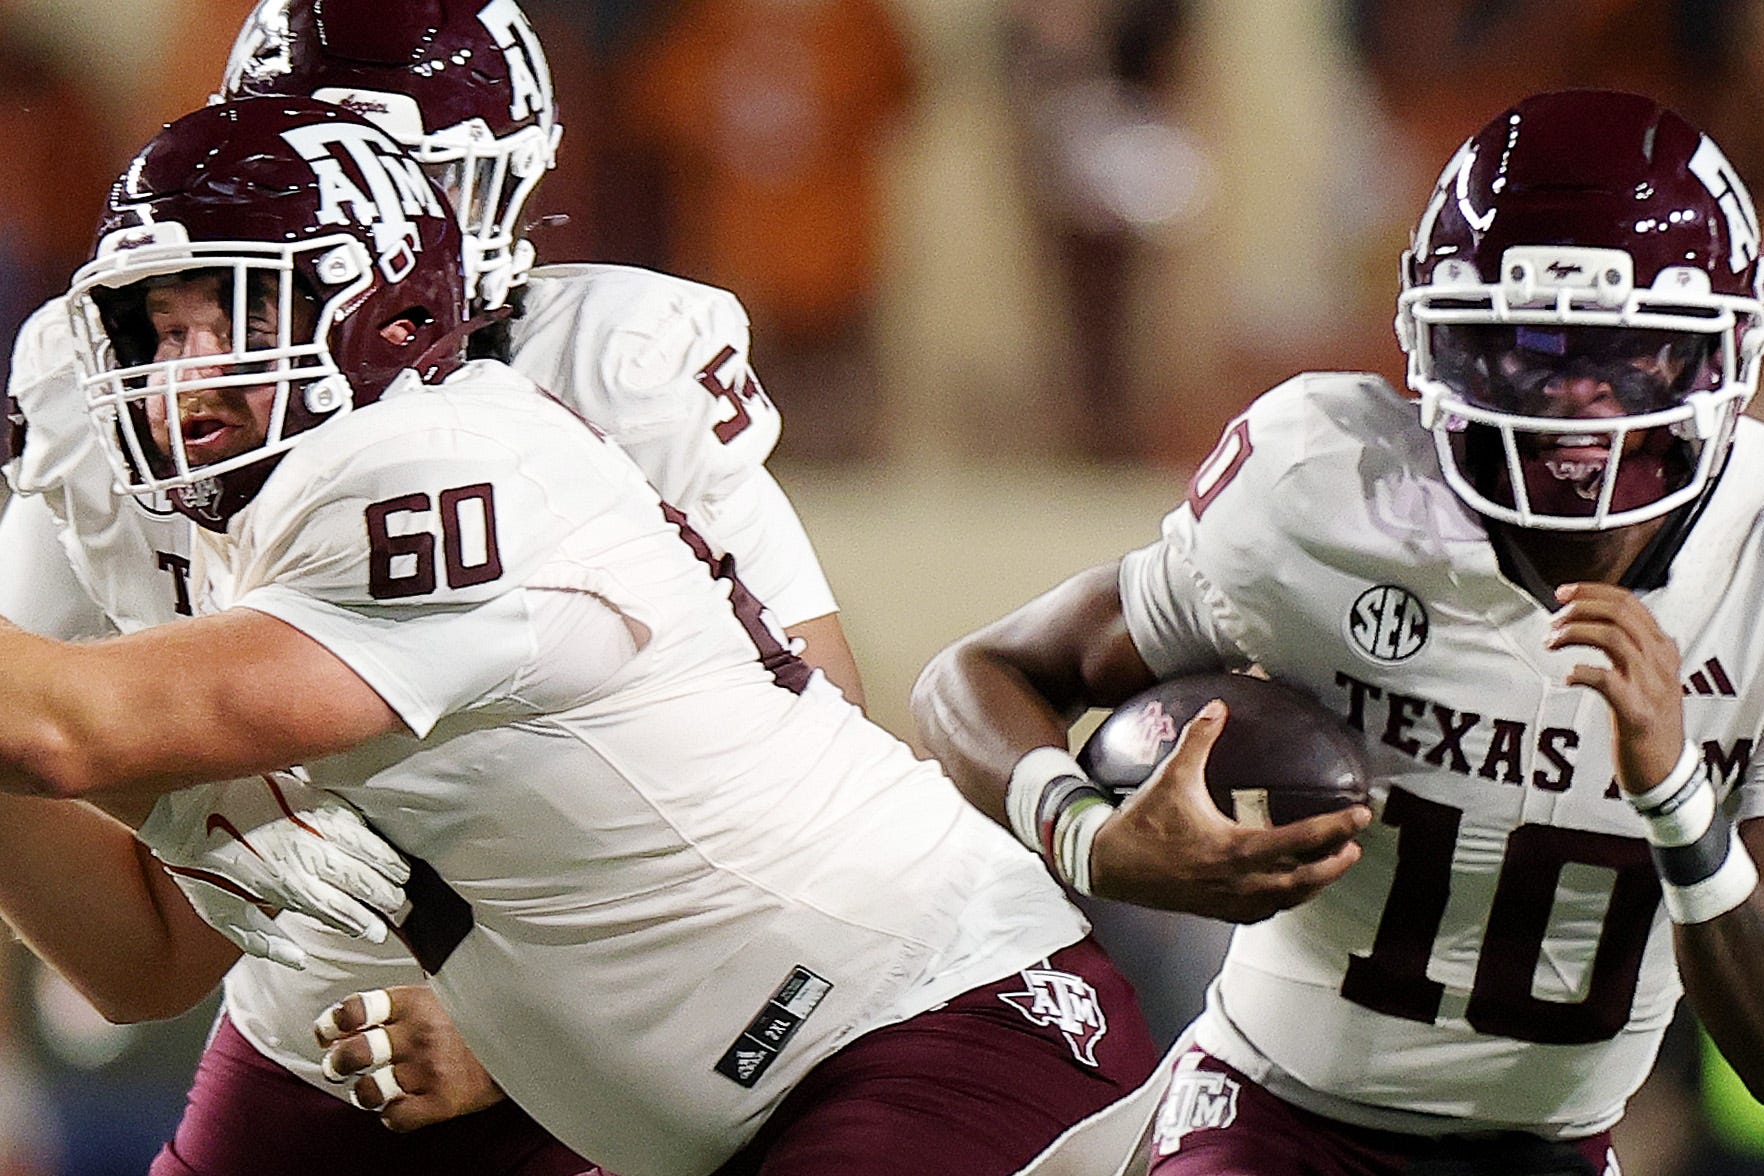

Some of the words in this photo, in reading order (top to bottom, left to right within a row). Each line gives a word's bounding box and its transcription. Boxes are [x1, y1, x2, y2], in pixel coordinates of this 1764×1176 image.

[365, 482, 503, 600] 60
[1349, 585, 1429, 660] SEC
[1335, 670, 1580, 793] TEXAS
[1340, 784, 1662, 1046] 10
